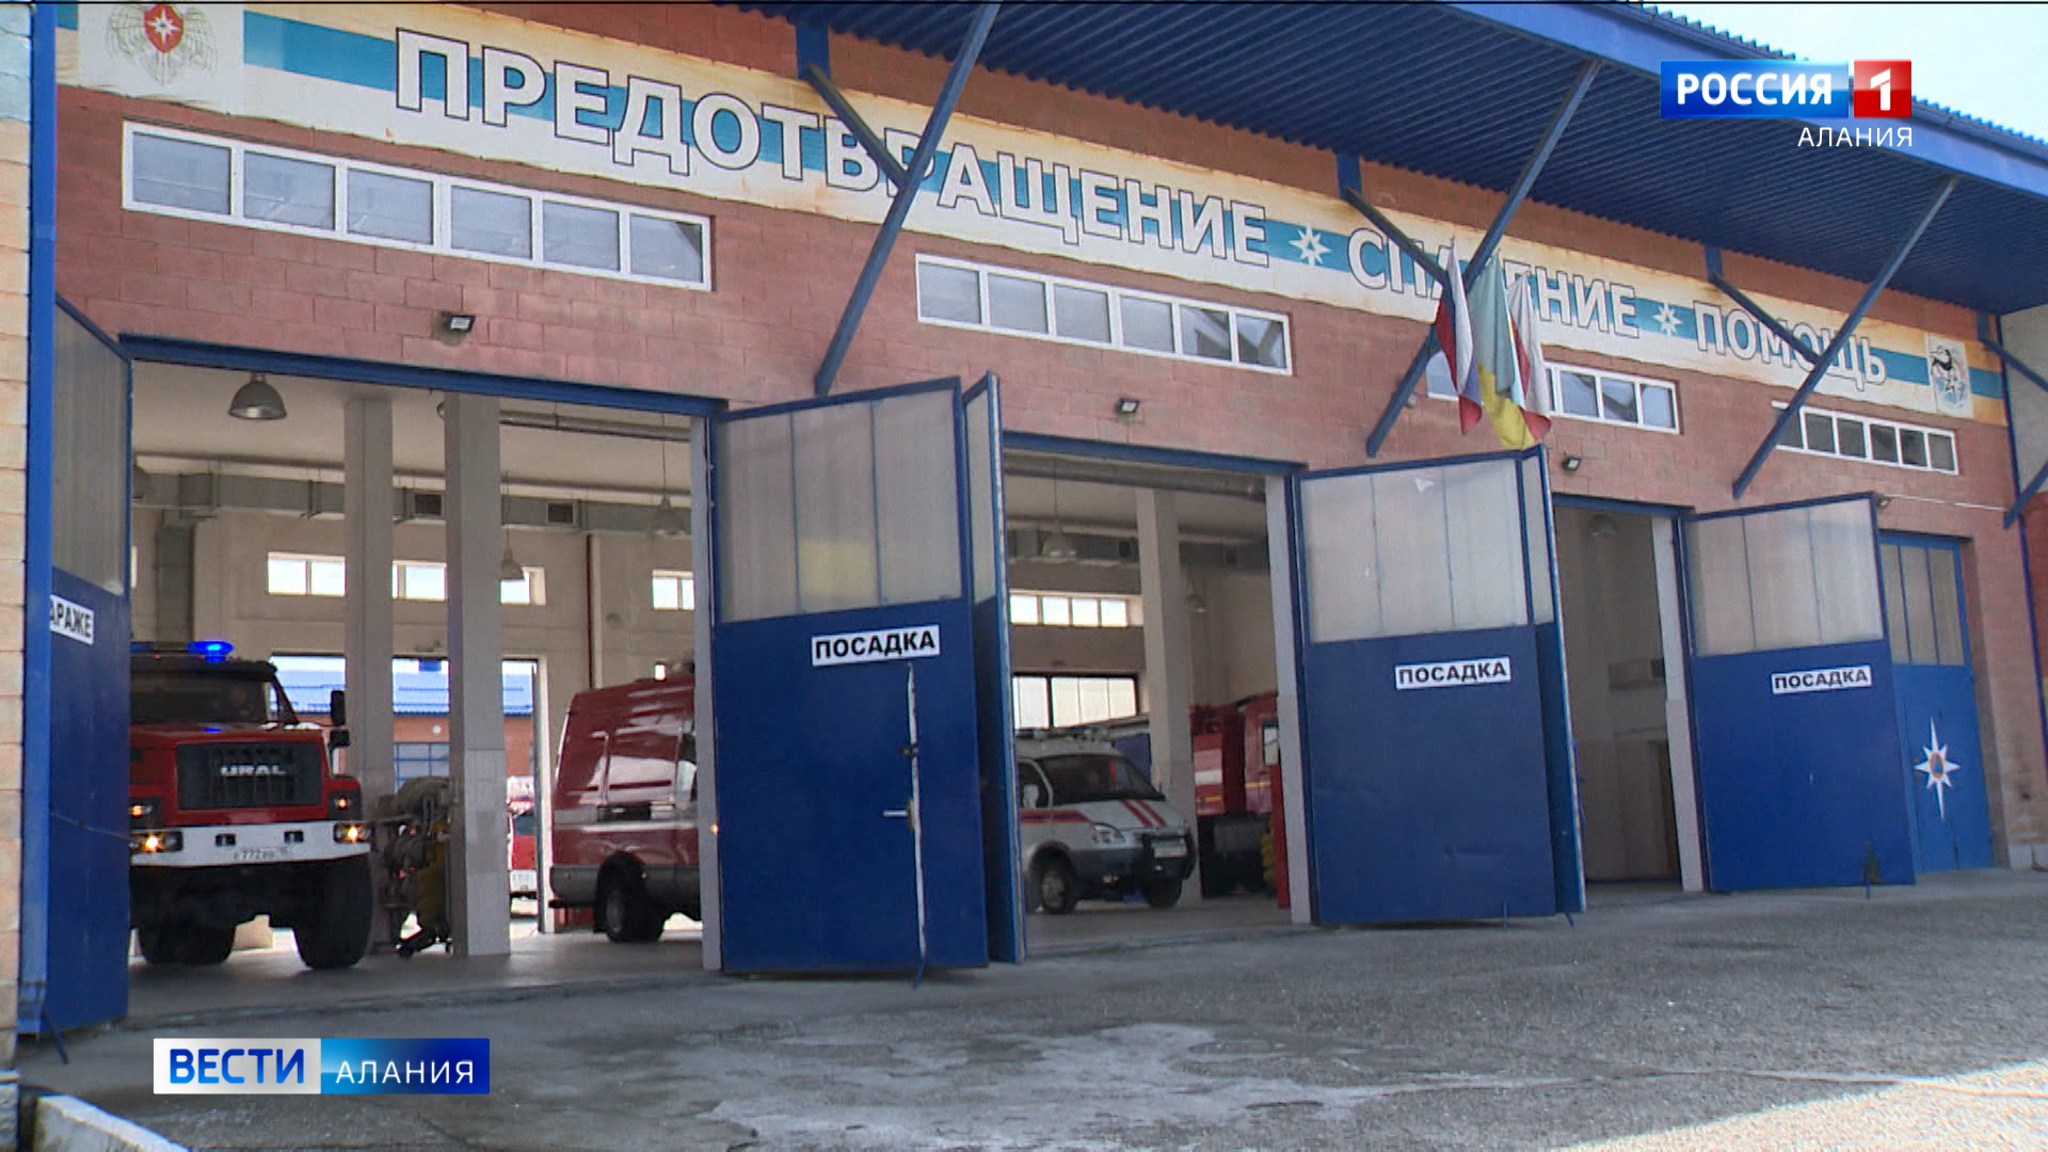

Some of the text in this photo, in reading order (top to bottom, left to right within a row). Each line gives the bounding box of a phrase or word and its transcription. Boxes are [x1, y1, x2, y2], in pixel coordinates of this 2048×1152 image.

[396, 27, 1270, 267] ПРЕДОТВРАЩЕНИЕ
[1348, 227, 1640, 338] СПНИЕ
[815, 630, 936, 659] ПОСАДКА
[1398, 661, 1508, 685] ПОСАДКА
[1774, 669, 1869, 689] ПОСАДКА
[221, 765, 287, 777] URAL
